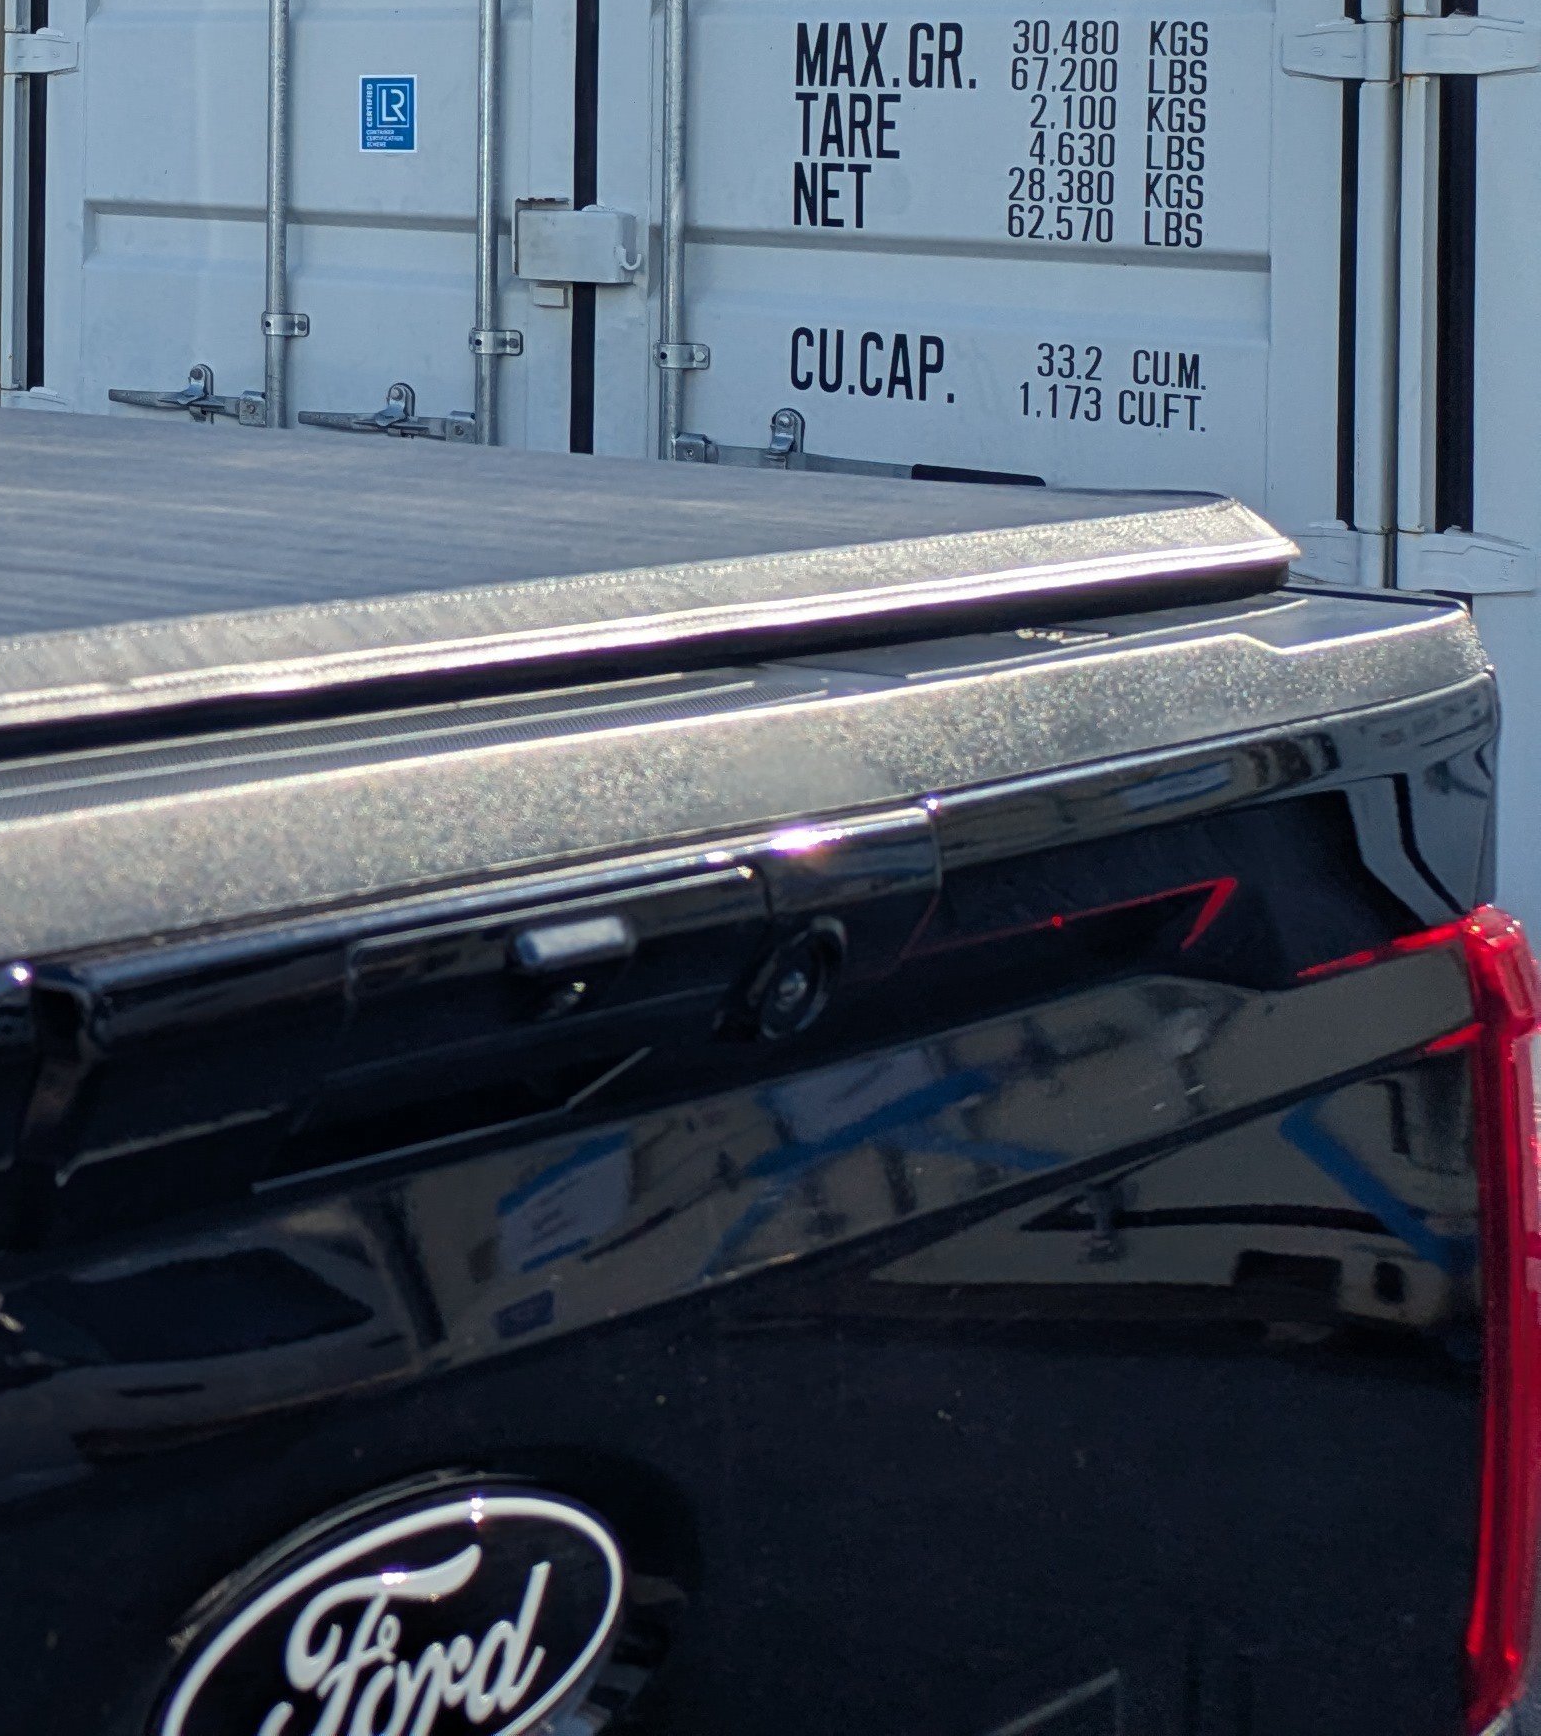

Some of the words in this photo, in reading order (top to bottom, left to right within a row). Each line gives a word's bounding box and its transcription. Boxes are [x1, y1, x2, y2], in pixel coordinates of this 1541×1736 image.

[1013, 20, 1118, 55] 30,480
[1150, 21, 1208, 56] KGS
[1012, 57, 1117, 92] 67,200
[1148, 59, 1207, 95] LBS
[382, 89, 407, 122] LR
[796, 92, 901, 159] TARE
[1030, 94, 1116, 130] 2,100
[1147, 97, 1205, 133] KGS
[1030, 131, 1115, 167] 4,630
[1146, 135, 1204, 171] LBS
[794, 162, 871, 228] NET
[1009, 167, 1114, 205] 28,380
[1145, 173, 1203, 209] KGS
[1008, 204, 1113, 242] 62,570
[1145, 211, 1202, 248] LBS
[1038, 343, 1102, 381] 33.2
[1133, 350, 1206, 390] CU.M.
[1021, 382, 1101, 421] 1,173
[1119, 390, 1205, 432] CU.FT.
[258, 1544, 551, 1736] Ford
